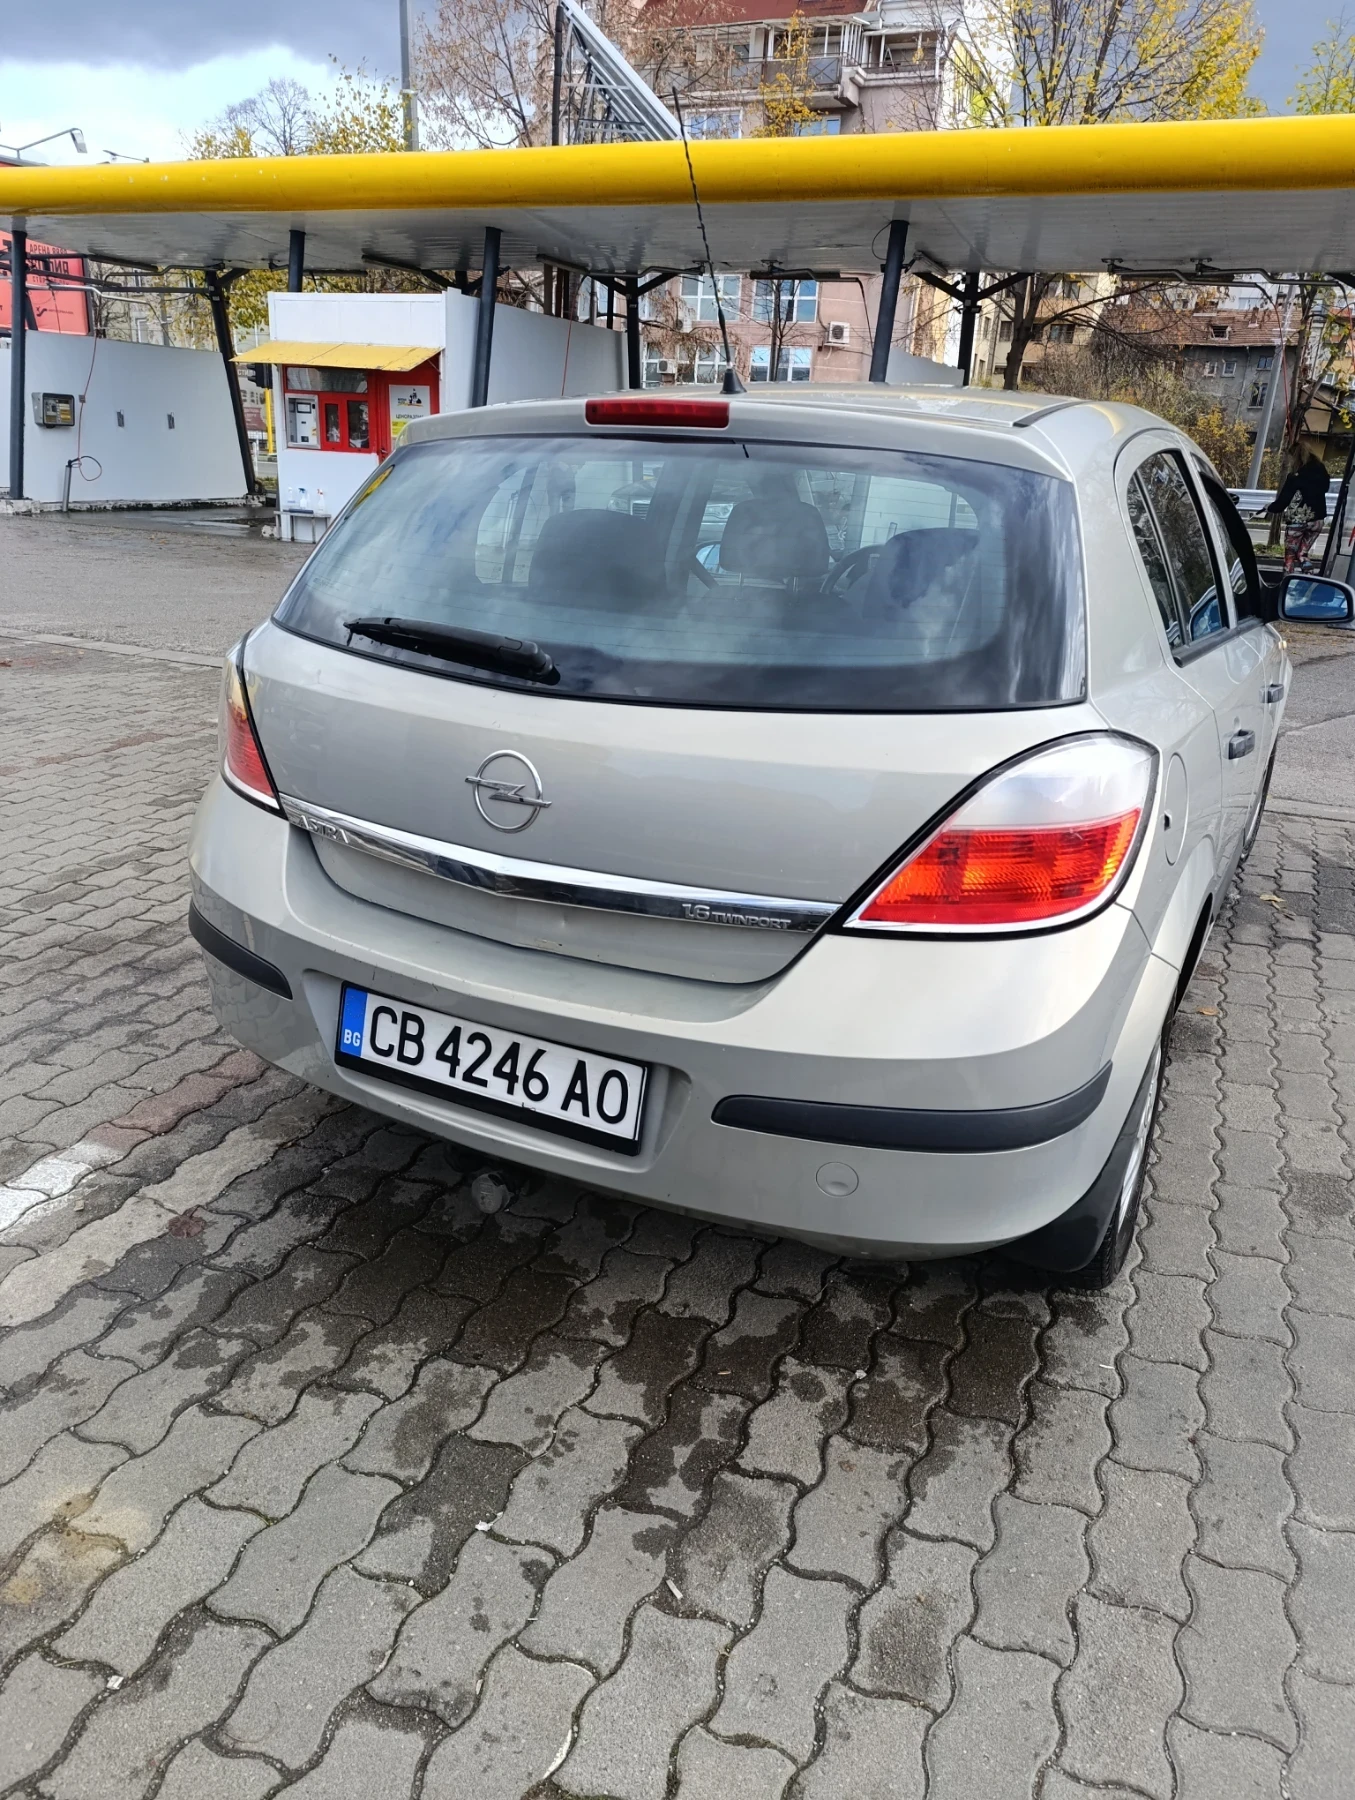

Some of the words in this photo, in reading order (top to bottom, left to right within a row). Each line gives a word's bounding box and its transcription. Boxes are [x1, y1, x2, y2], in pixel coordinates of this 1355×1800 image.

[299, 814, 349, 844] ASTRA
[711, 911, 791, 930] TWINPORT
[343, 1028, 361, 1047] BG
[369, 1005, 425, 1066] CB
[435, 1025, 549, 1102] 4246
[560, 1059, 631, 1124] AO
